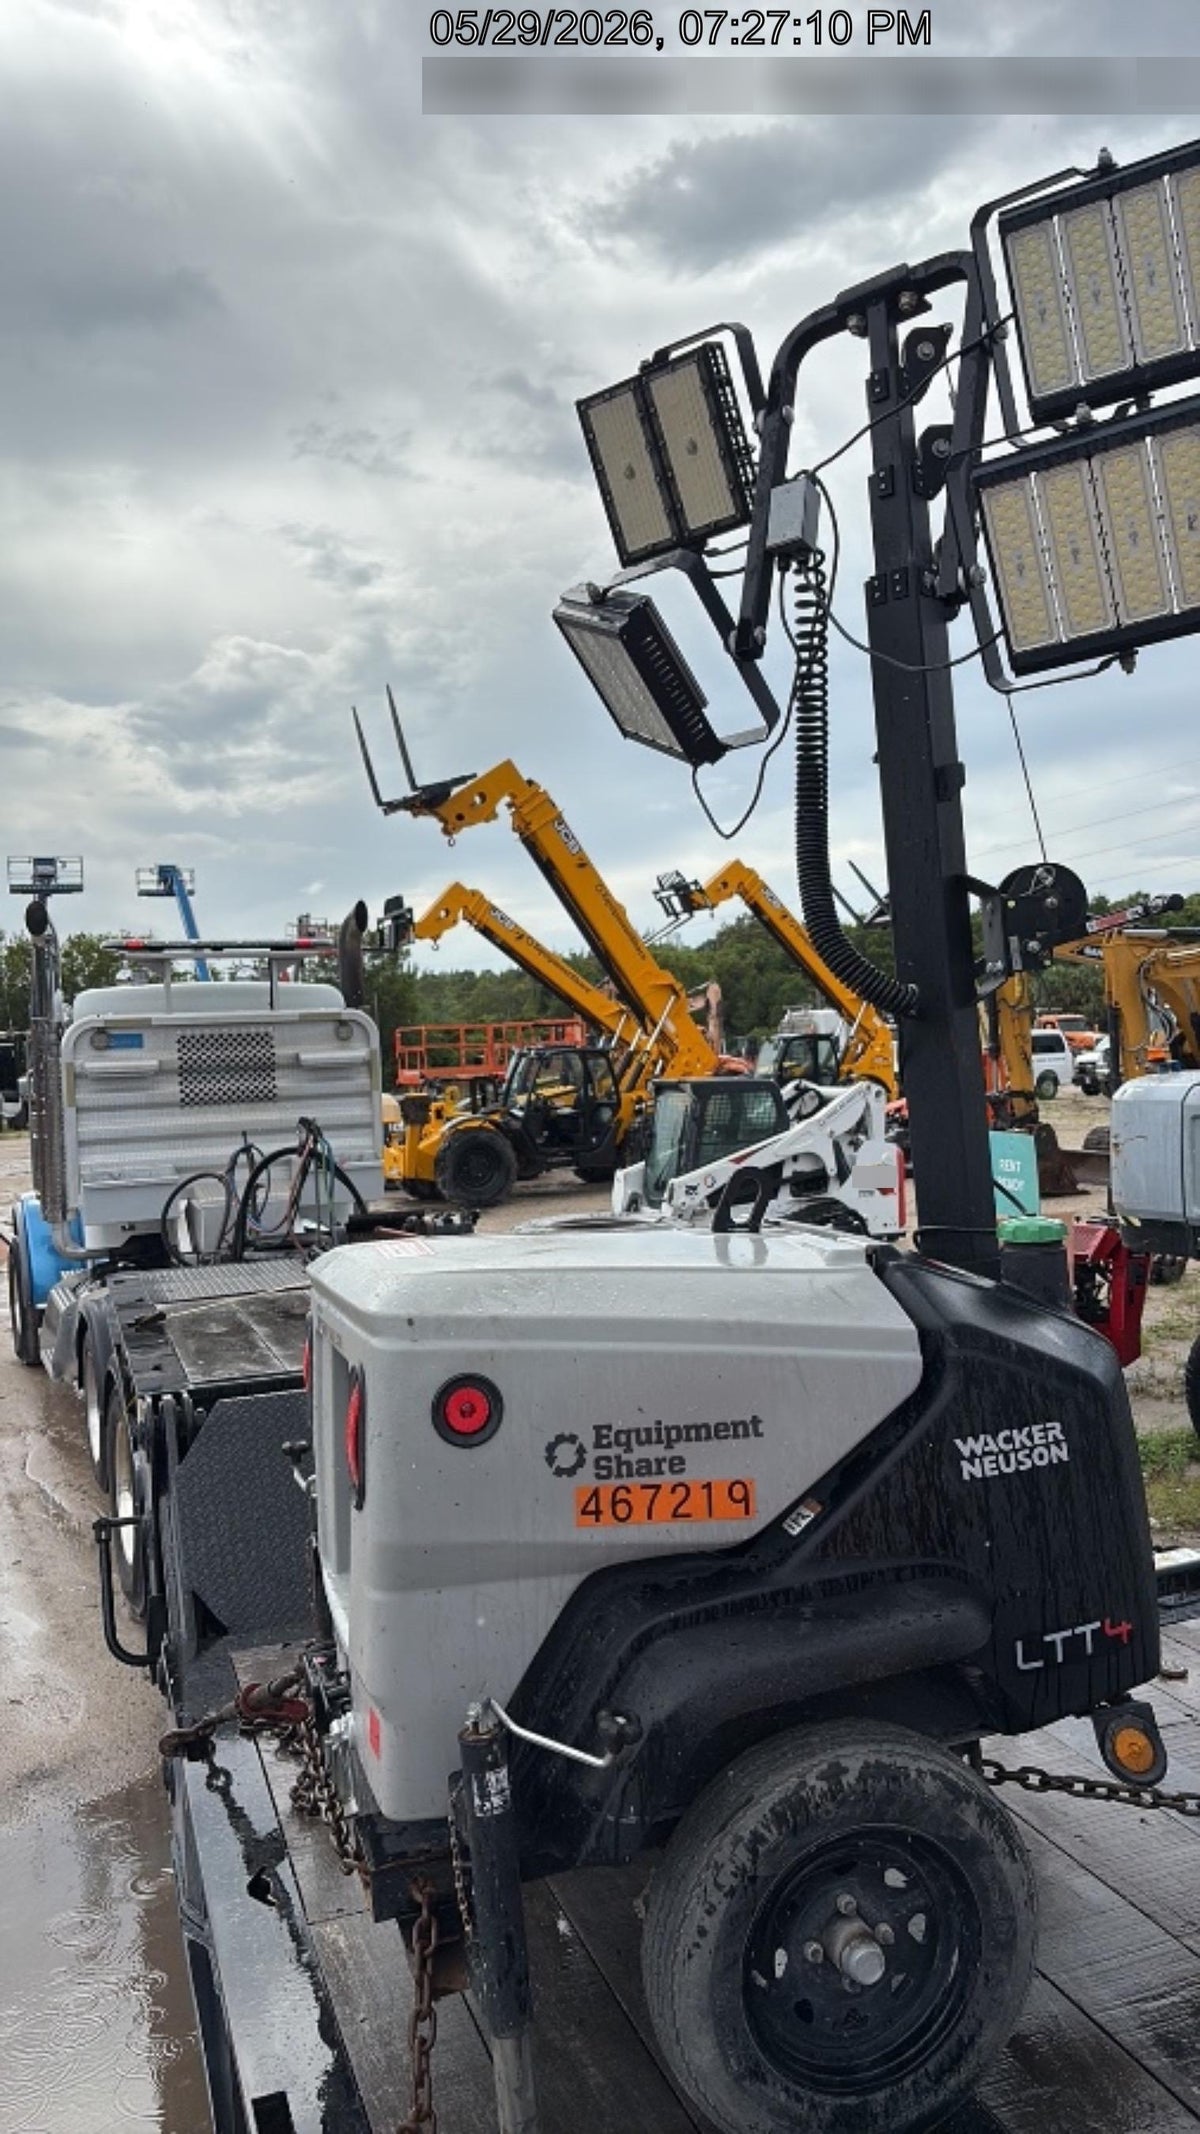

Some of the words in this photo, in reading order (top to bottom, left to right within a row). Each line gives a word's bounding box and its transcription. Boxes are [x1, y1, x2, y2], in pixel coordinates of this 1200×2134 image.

[592, 1415, 764, 1453] Equipment
[953, 1421, 1066, 1458] WACKER
[593, 1455, 687, 1480] Share
[960, 1443, 1070, 1481] NEUSON
[579, 1480, 752, 1523] 467219
[1015, 1617, 1133, 1671] LTT4
